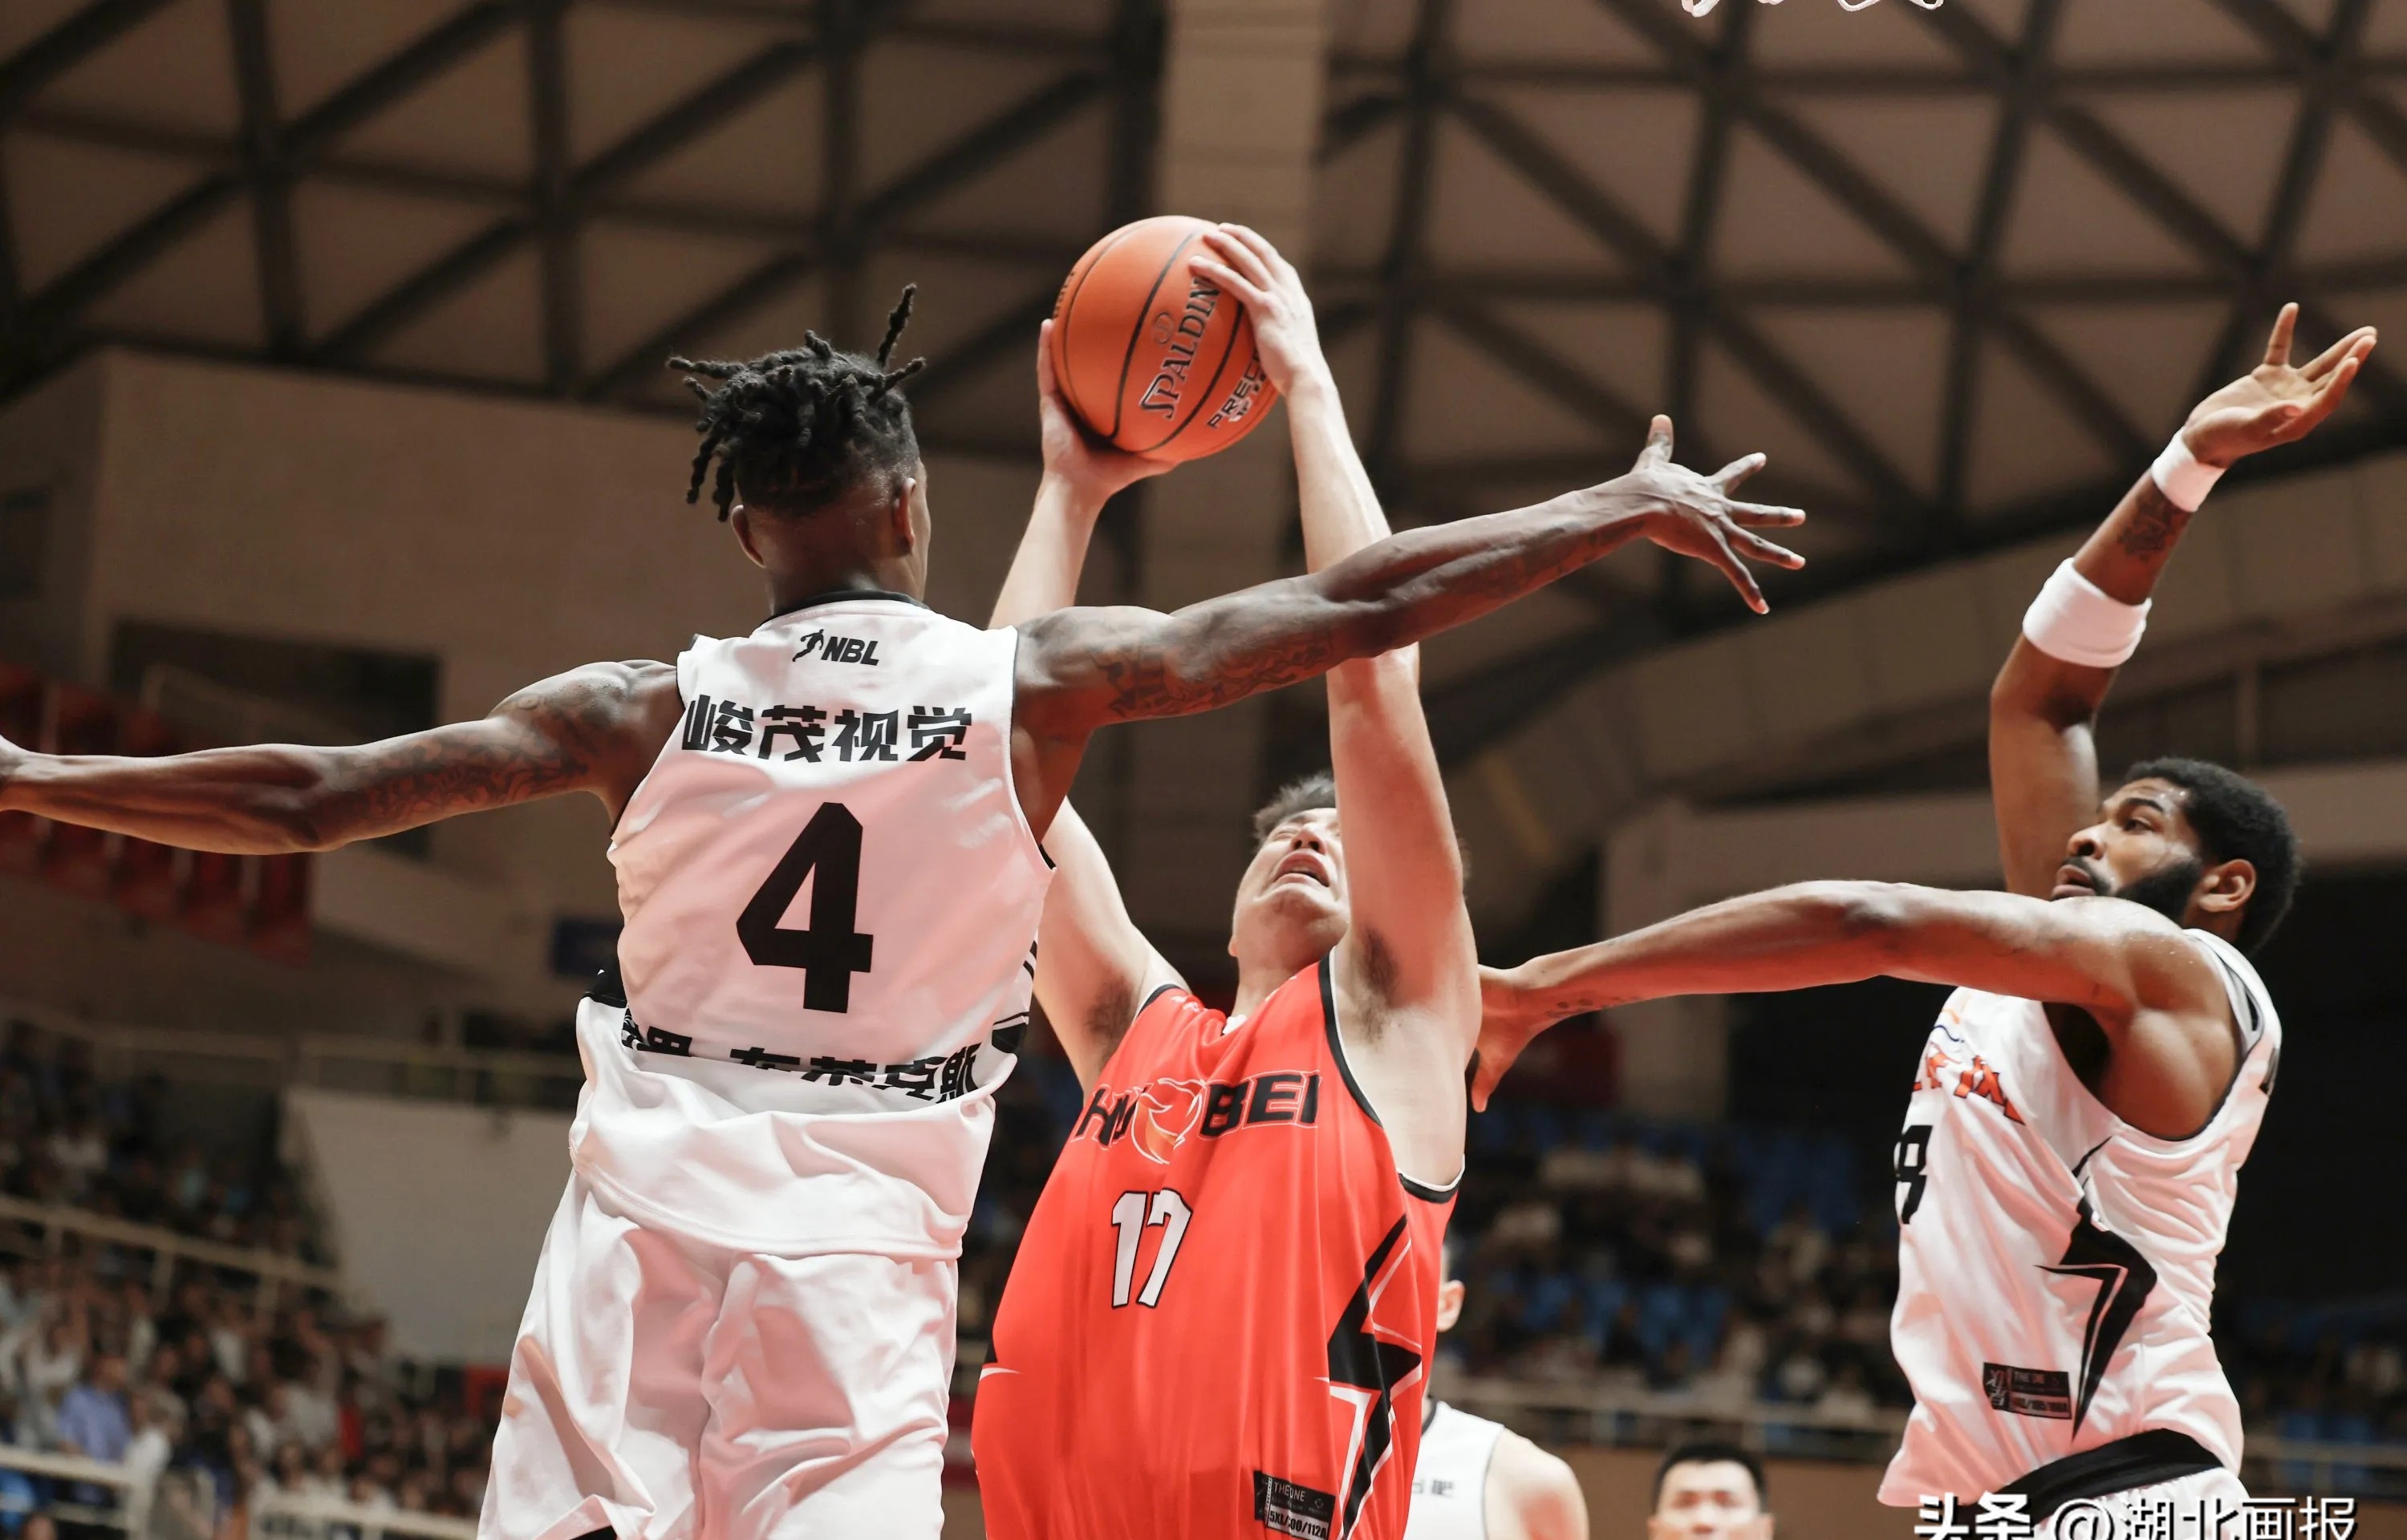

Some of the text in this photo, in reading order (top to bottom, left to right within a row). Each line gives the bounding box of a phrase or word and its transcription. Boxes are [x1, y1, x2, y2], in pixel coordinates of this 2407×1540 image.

[1140, 276, 1220, 419] SPALDIN
[1207, 348, 1259, 429] PREC
[821, 636, 879, 666] NBL
[681, 694, 972, 764] 峻茂视觉
[736, 801, 874, 1014] 4
[1111, 1187, 1193, 1309] 17
